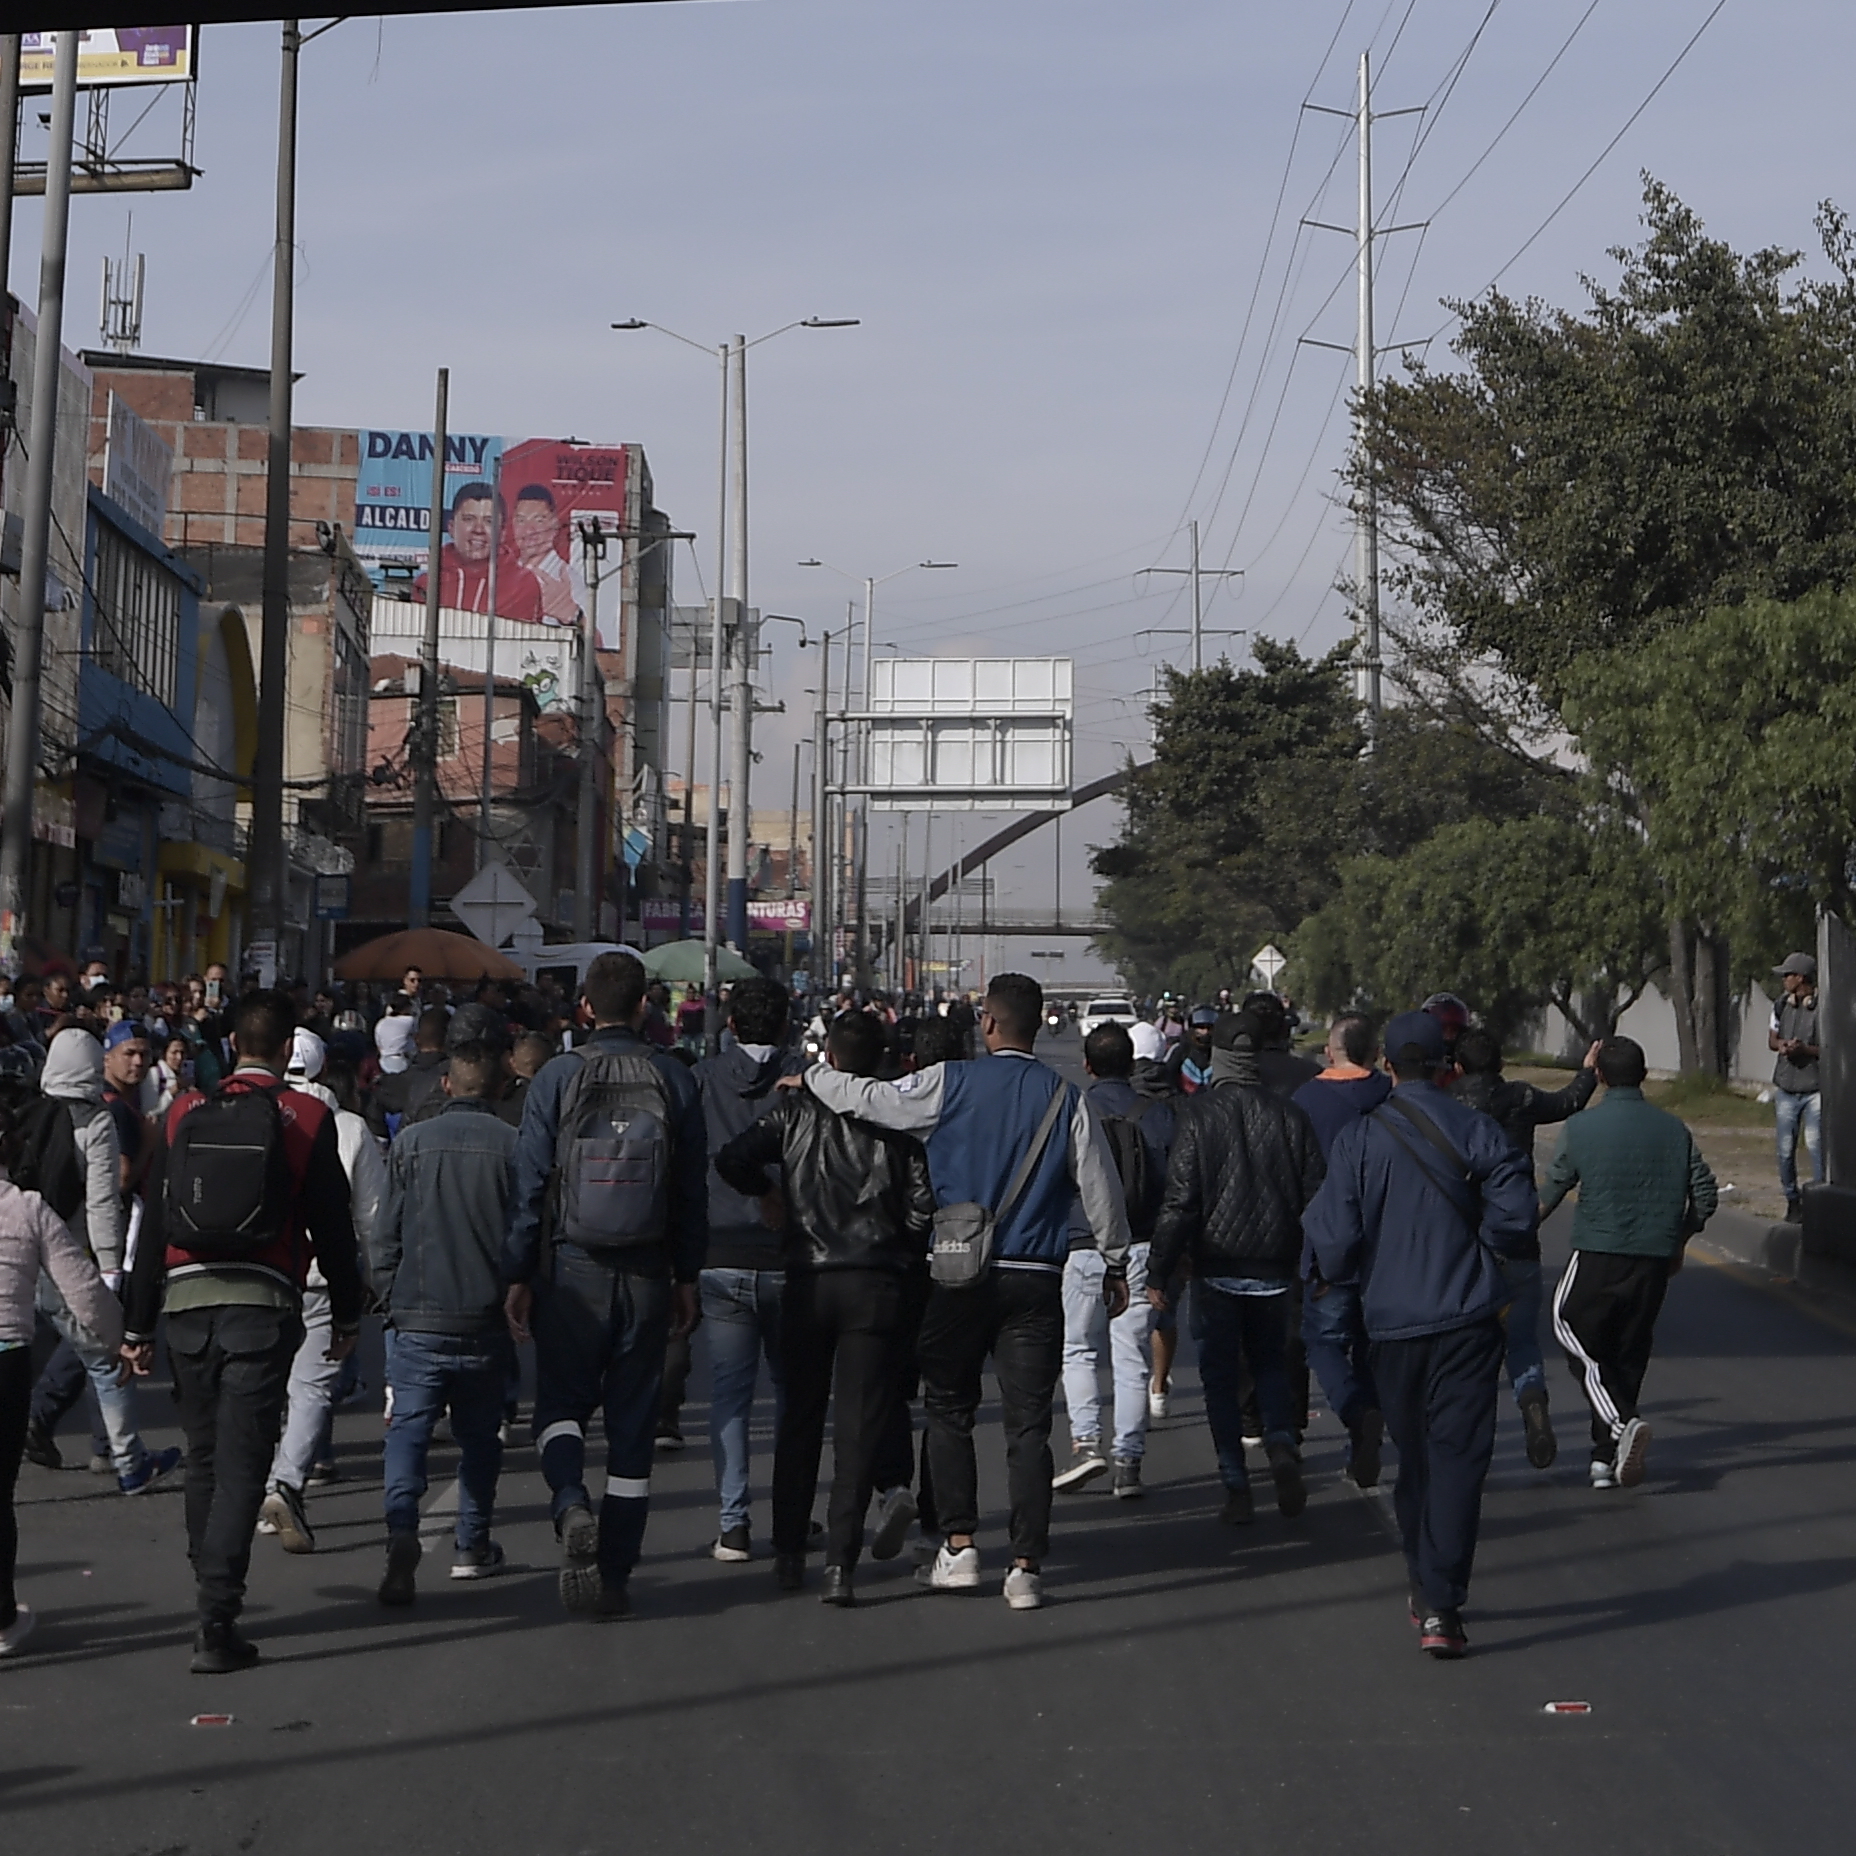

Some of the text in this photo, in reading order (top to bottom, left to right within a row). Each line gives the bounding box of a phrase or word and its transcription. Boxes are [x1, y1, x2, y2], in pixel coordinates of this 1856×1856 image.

[367, 430, 491, 464] DANNY
[556, 466, 616, 481] TIQUE
[361, 505, 431, 530] ALCALD
[644, 902, 707, 918] FABRCA
[746, 901, 806, 918] NTURAS
